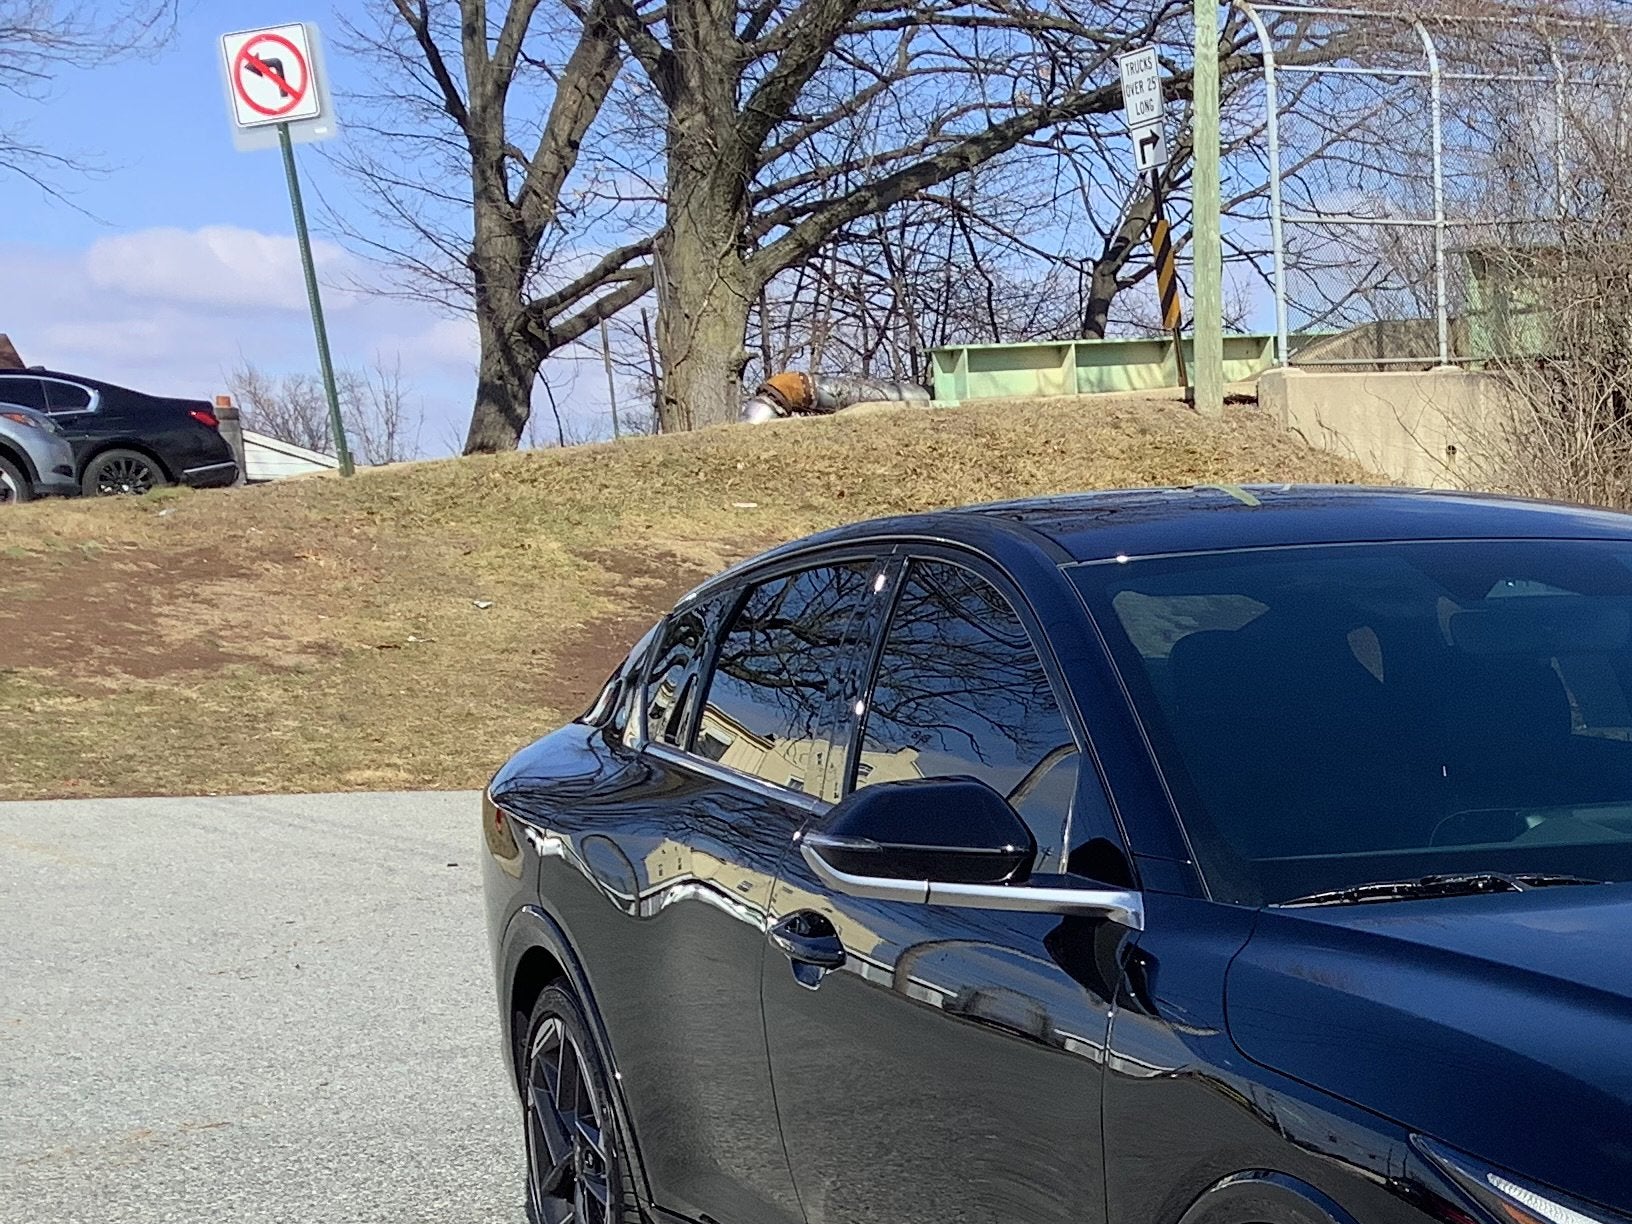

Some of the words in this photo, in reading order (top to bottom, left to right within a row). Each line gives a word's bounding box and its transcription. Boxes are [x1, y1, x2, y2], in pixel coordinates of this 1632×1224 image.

[1125, 56, 1153, 76] TRUCKS
[1125, 80, 1145, 98] OVER
[1135, 98, 1154, 116] LONG
